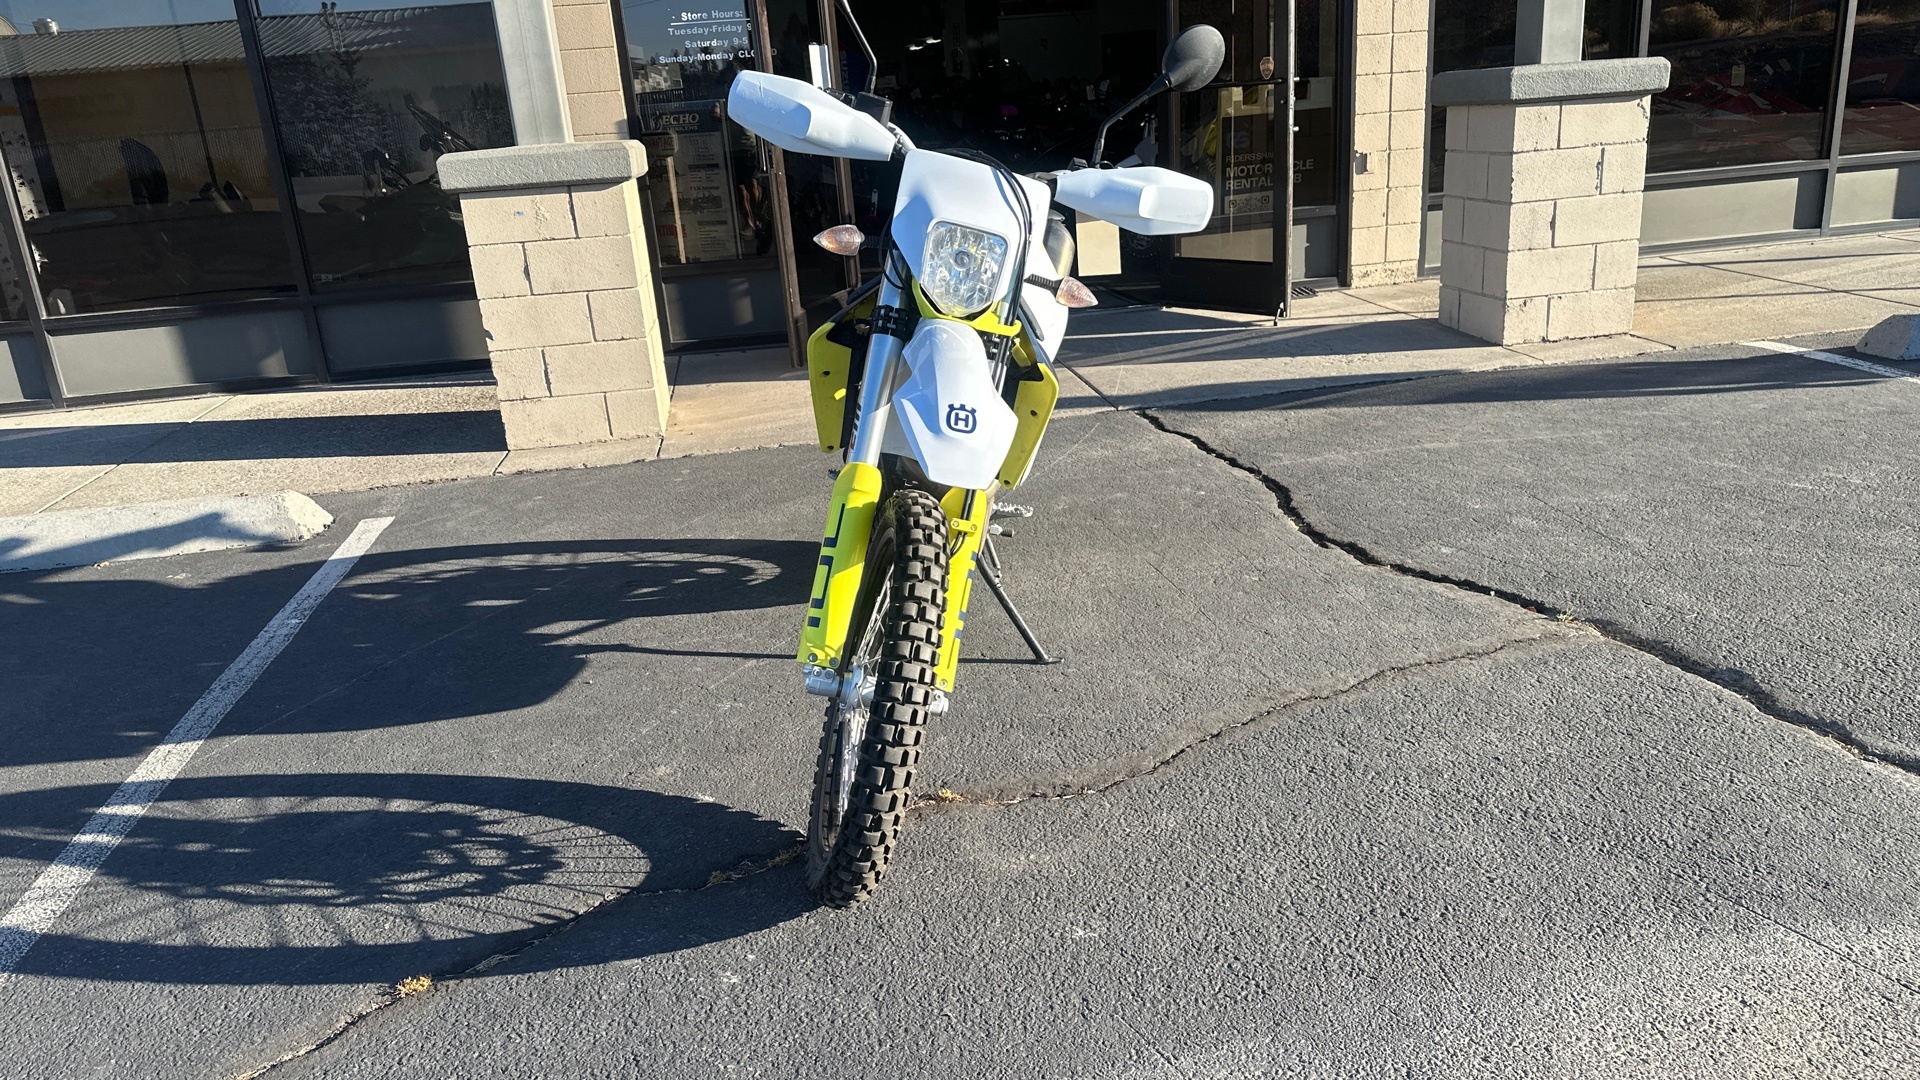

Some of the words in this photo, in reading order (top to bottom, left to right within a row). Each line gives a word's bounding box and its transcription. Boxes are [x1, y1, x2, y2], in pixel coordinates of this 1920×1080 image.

[681, 12, 708, 21] Store
[711, 10, 743, 19] Hours:
[667, 23, 743, 36] Tuesday-Friday
[685, 38, 729, 48] Saturday
[733, 37, 749, 45] 9-5
[659, 52, 734, 64] Sunday-Monday
[738, 48, 778, 58] CLD
[662, 113, 700, 125] ECHO
[1226, 153, 1256, 163] RIDERS
[1256, 151, 1274, 160] SHA
[1226, 176, 1274, 191] RENTAL
